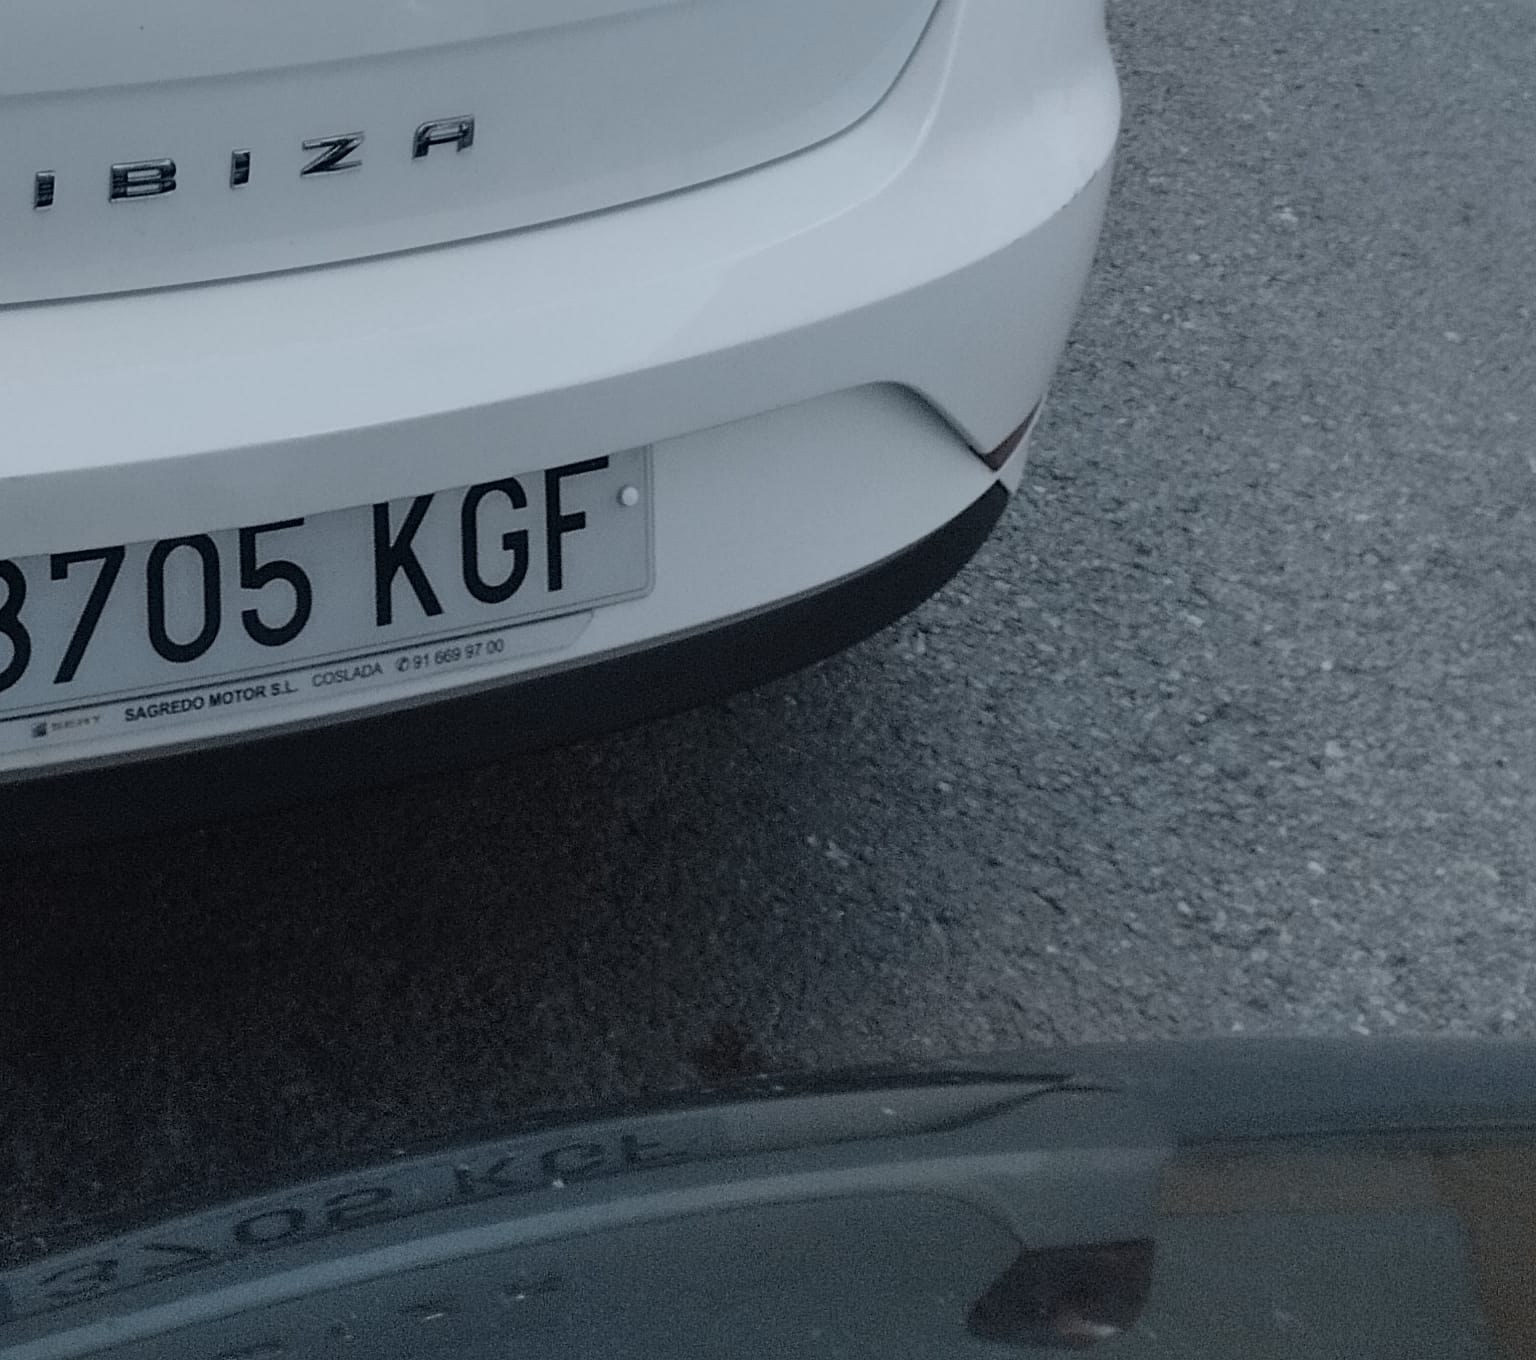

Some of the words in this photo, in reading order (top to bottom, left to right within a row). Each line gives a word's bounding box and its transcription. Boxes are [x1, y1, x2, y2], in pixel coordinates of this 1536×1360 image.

[33, 114, 476, 210] IBIZA
[372, 454, 610, 627] KGF
[124, 695, 205, 722] SAGREDO
[209, 685, 267, 708] MOTOR
[270, 680, 299, 697] S.L.
[312, 662, 384, 687] COSLADA
[413, 653, 430, 669] 91
[466, 643, 482, 659] 97
[486, 638, 505, 654] 00
